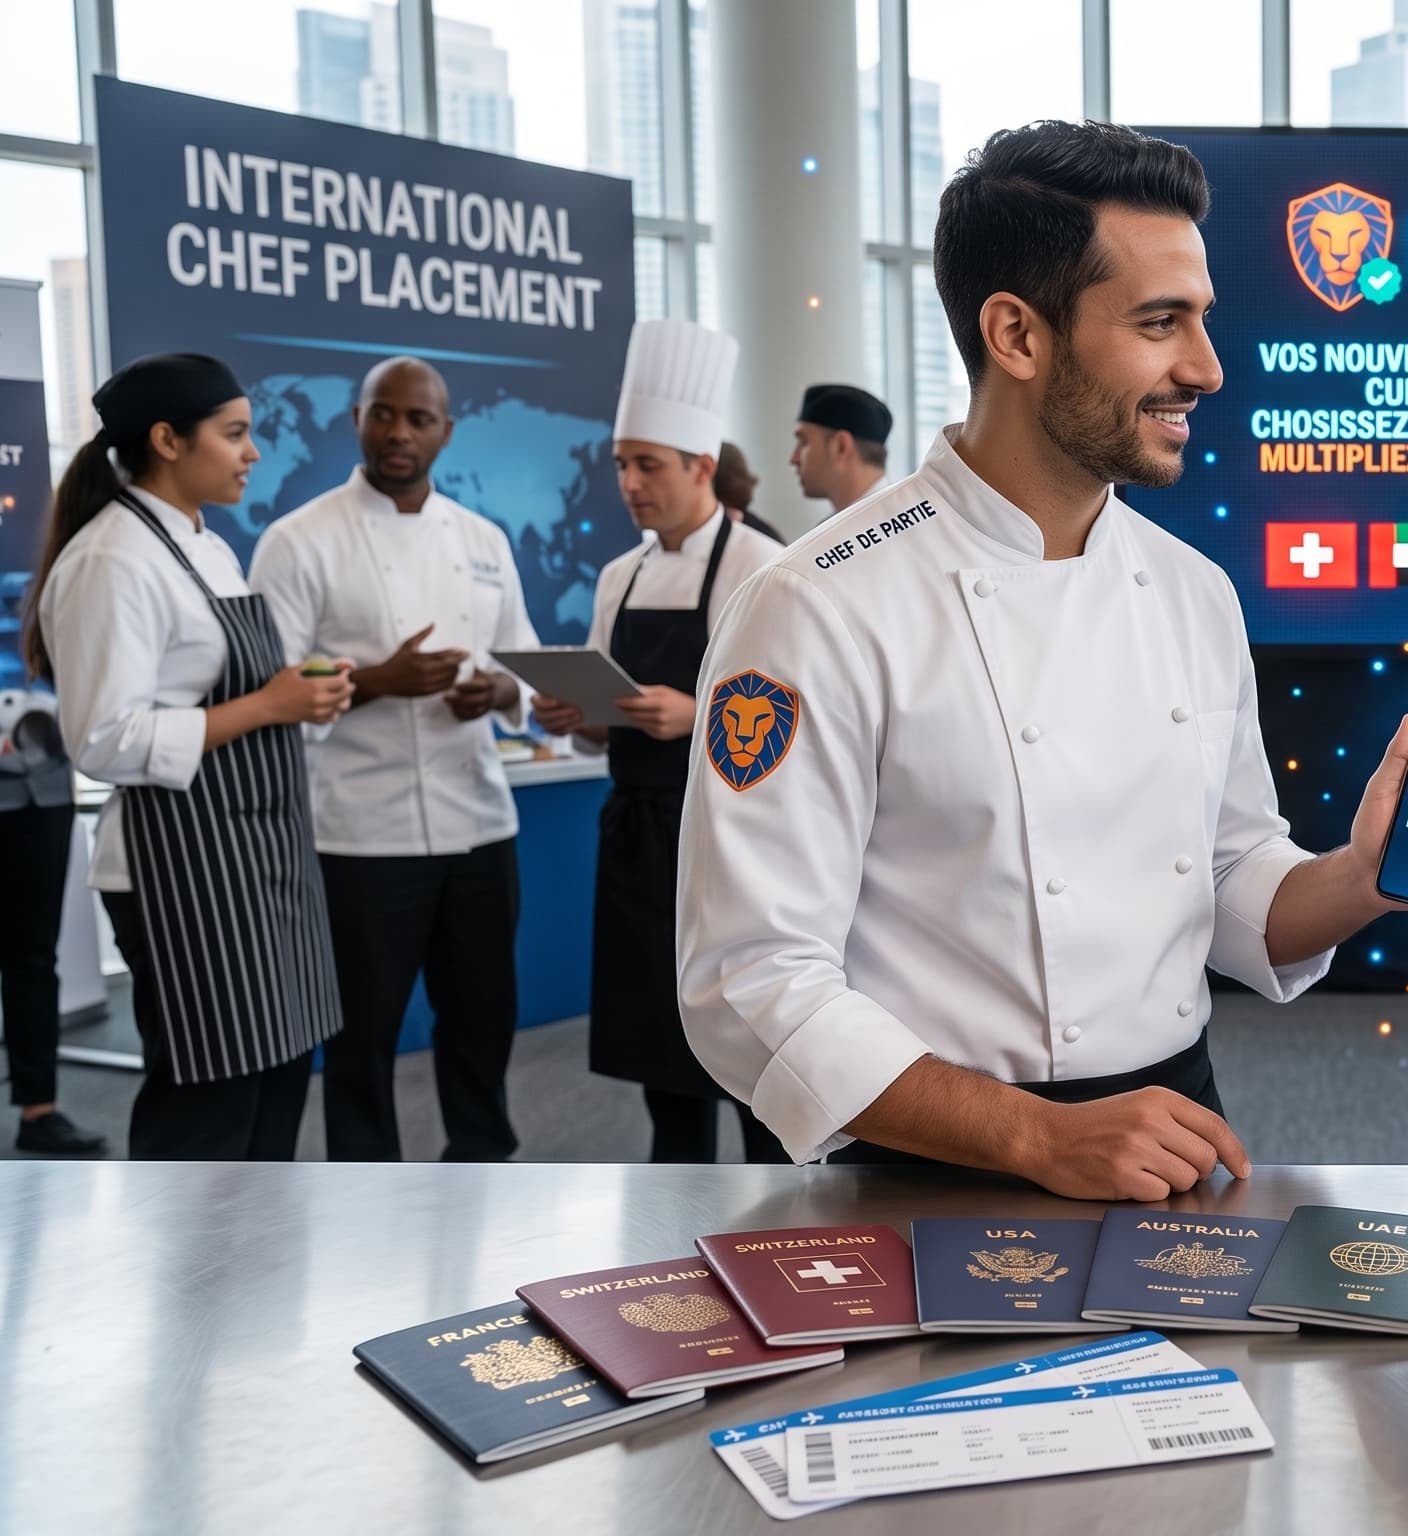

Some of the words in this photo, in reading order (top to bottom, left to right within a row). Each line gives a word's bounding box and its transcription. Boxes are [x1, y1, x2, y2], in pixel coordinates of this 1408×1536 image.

[183, 144, 582, 264] INTERNATIONAL
[167, 222, 309, 297] CHEF
[325, 244, 601, 331] PLACEMENT
[1259, 343, 1317, 373] VOS
[815, 540, 856, 570] CHEF
[856, 528, 882, 550] DE
[879, 500, 937, 538] PARTIE
[985, 1230, 1037, 1239] USA
[1136, 1221, 1260, 1238] AUSTRALIA
[1358, 1222, 1408, 1235] UAE
[735, 1236, 876, 1253] SWITZERLAND
[559, 1270, 710, 1299] SWITZERLAND
[427, 1314, 529, 1347] FRANCE
